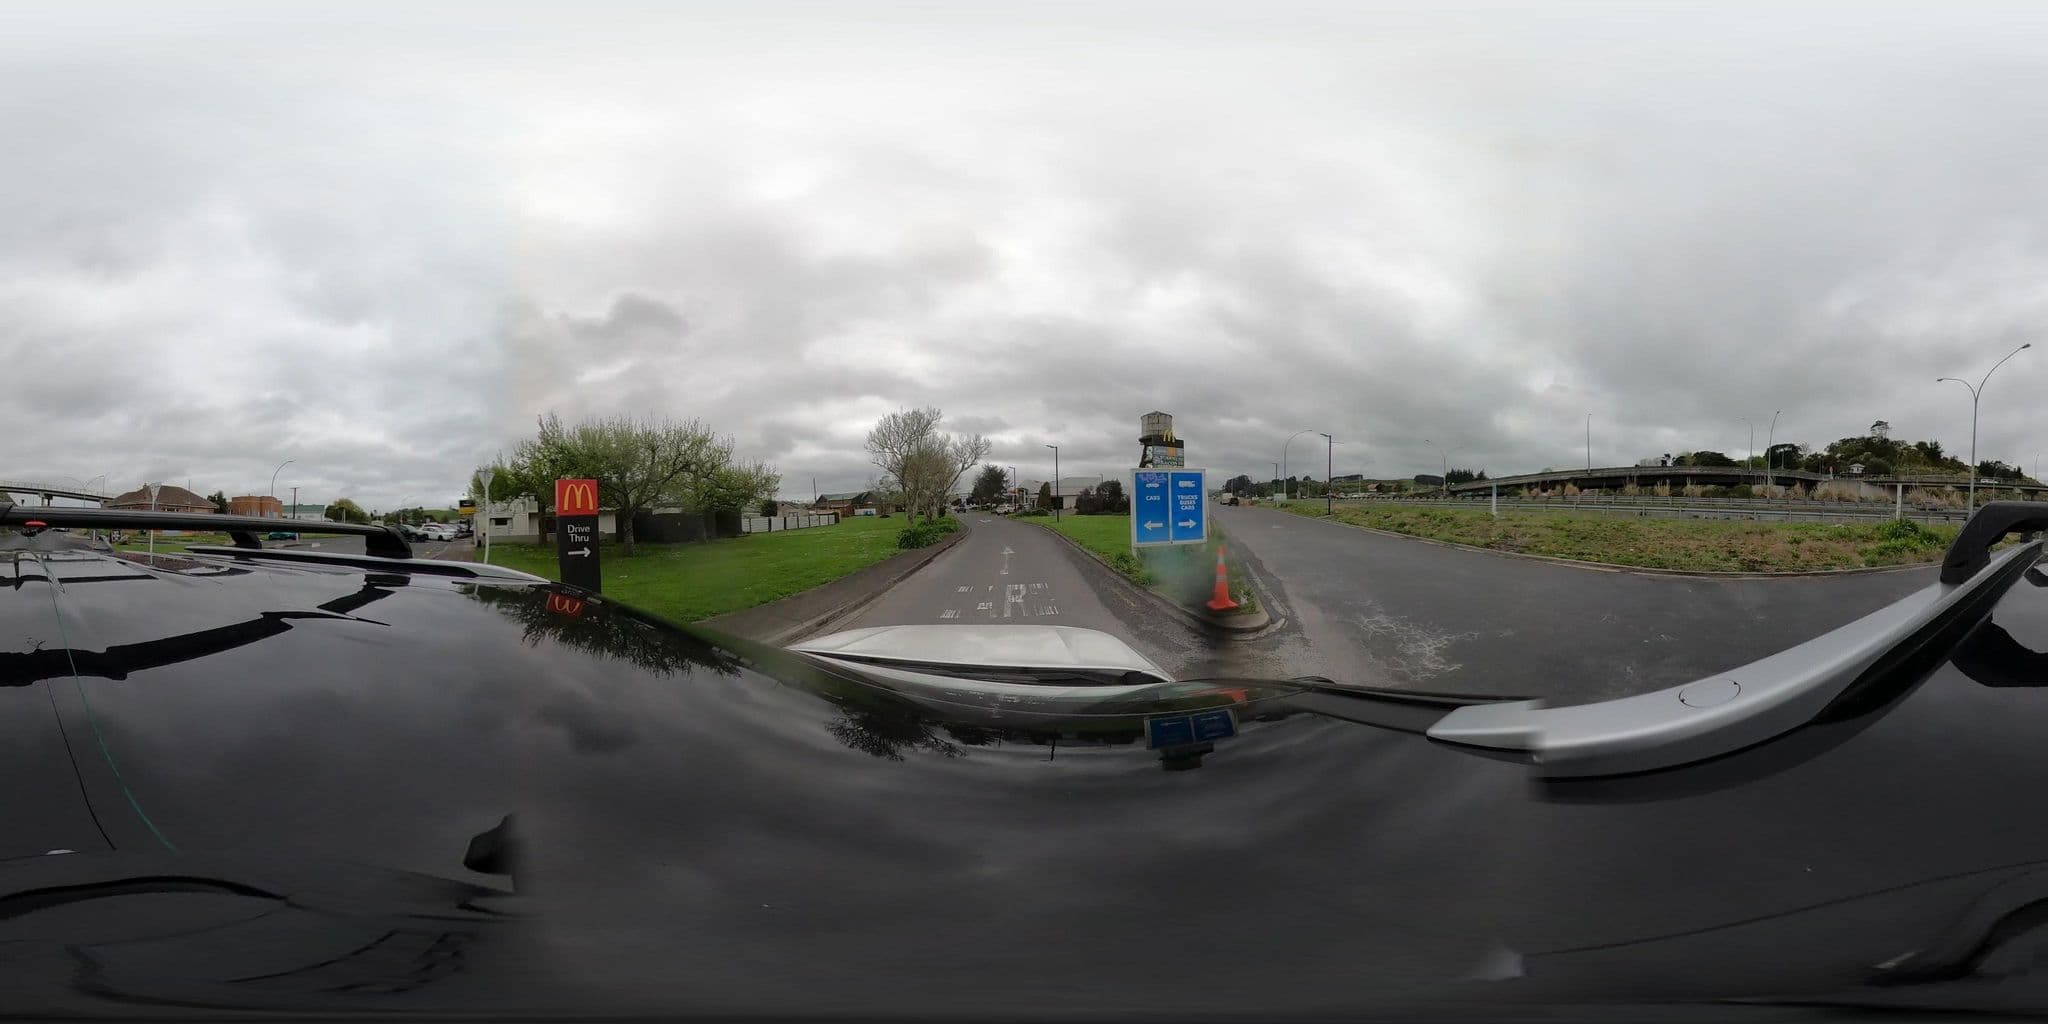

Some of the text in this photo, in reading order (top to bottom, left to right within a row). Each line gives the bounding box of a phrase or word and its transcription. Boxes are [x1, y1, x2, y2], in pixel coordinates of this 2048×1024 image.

[563, 483, 594, 511] M
[567, 524, 591, 533] Drive
[569, 533, 590, 543] Thru
